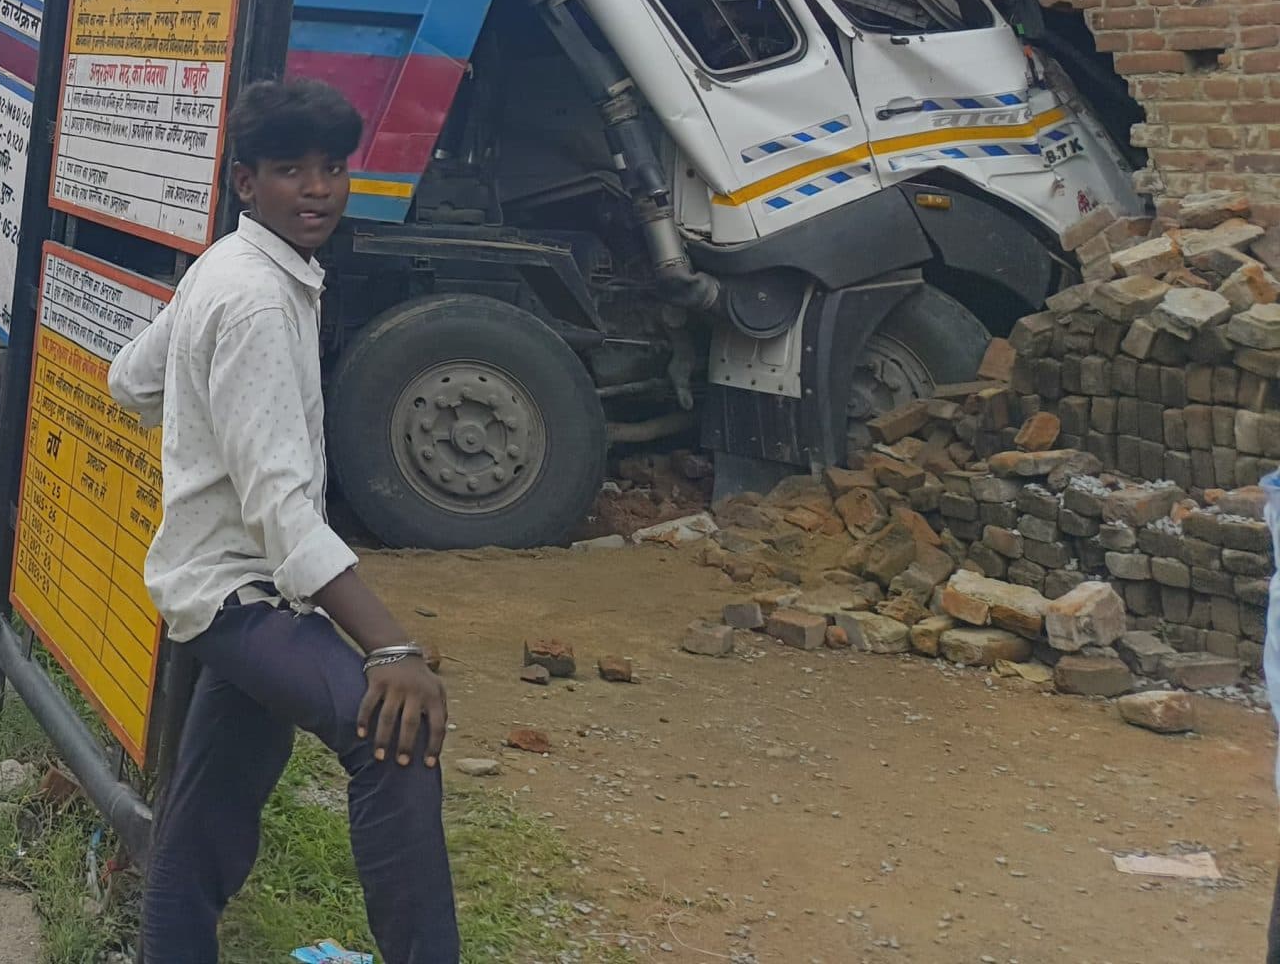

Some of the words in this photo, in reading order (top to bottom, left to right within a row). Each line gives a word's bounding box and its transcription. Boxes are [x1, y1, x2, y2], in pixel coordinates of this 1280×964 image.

[88, 61, 118, 88] अनुरक्षण
[130, 64, 144, 84] का
[141, 58, 169, 89] विवरण
[45, 422, 62, 463] वर्ष
